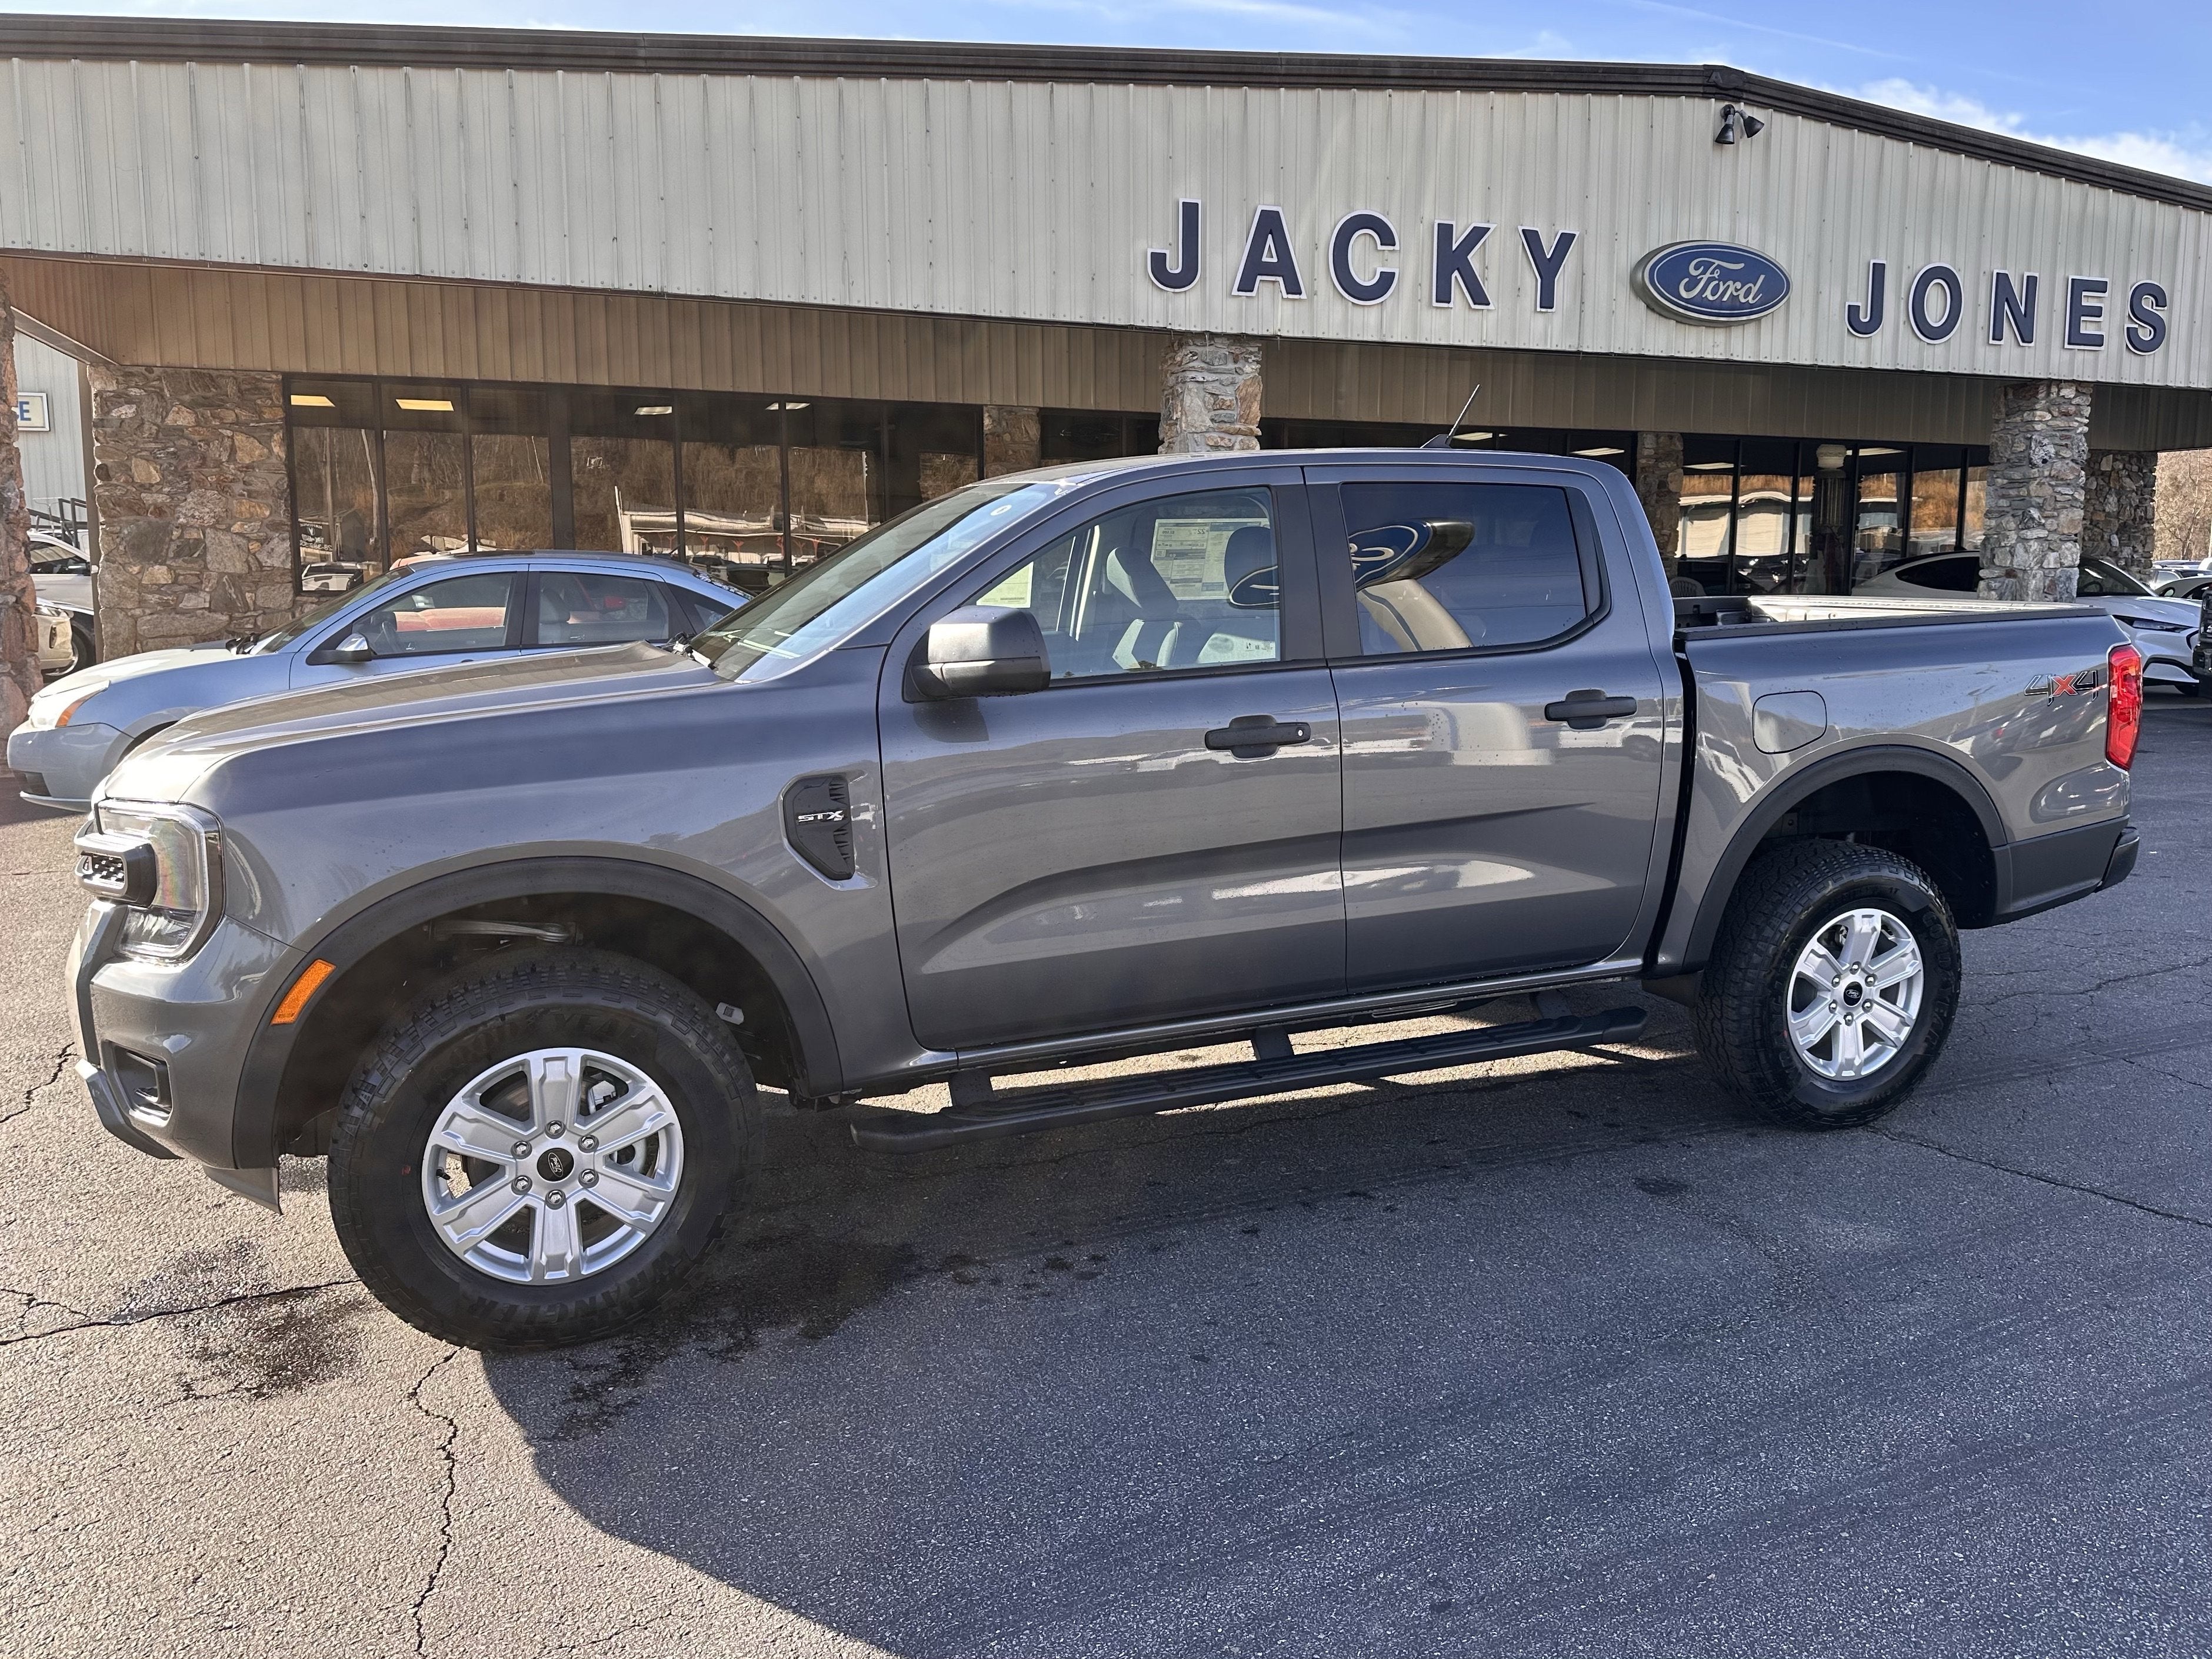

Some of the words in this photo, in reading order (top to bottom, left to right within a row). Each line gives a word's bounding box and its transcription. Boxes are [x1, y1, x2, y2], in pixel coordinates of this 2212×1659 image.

[1147, 198, 1580, 312] JACKY
[1678, 257, 1765, 304] Ford
[1845, 259, 2168, 355] JONES
[16, 401, 31, 421] E
[798, 809, 844, 822] STX
[550, 1157, 562, 1173] Ford
